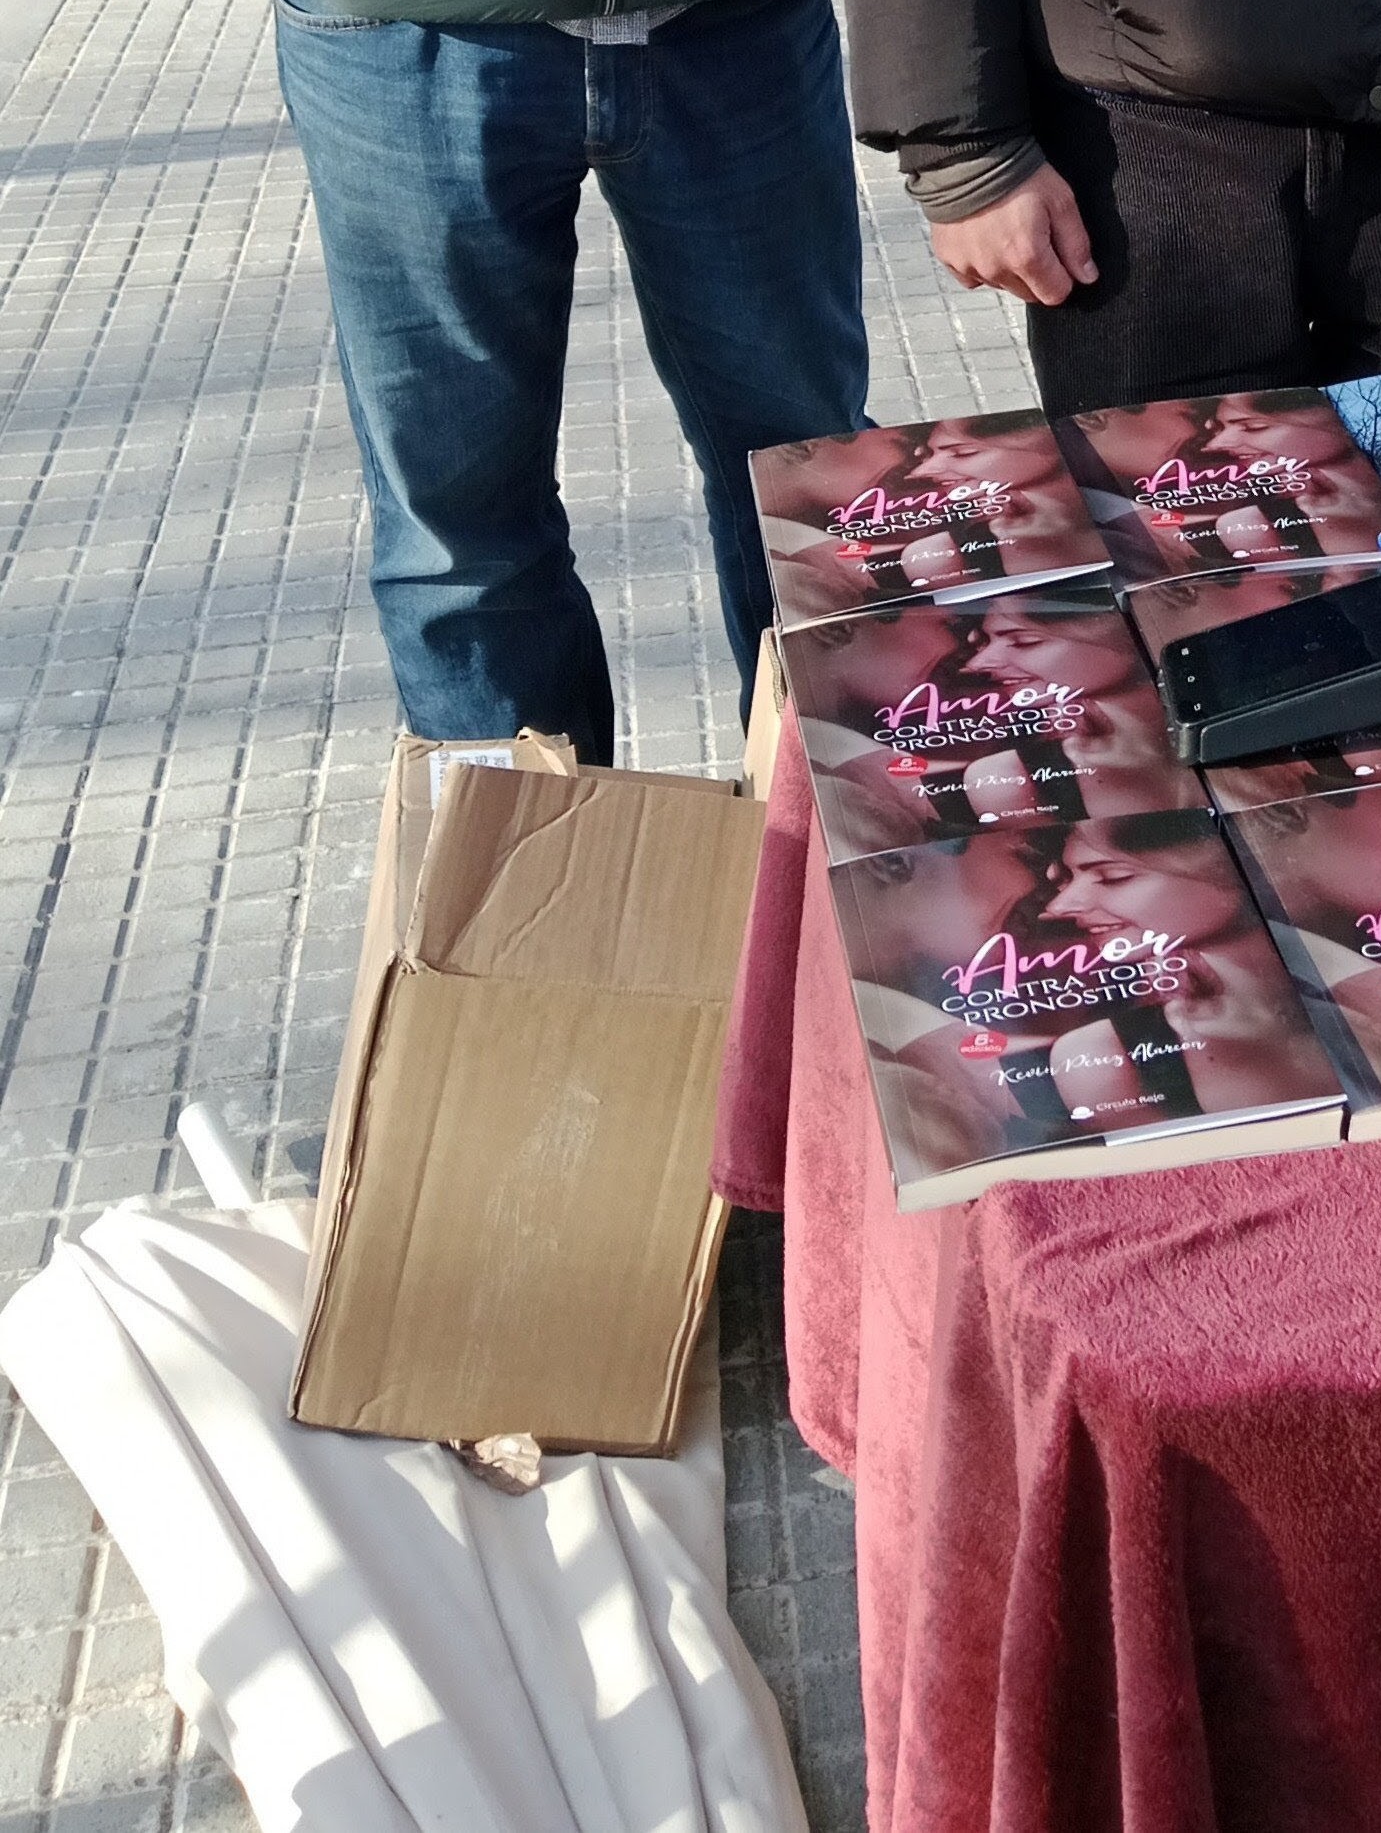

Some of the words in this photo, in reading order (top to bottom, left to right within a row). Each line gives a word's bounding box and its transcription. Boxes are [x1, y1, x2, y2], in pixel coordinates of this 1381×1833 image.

[1134, 455, 1311, 493] Amor
[1135, 481, 1238, 505] CONTRA
[1245, 470, 1312, 488] TODO
[826, 508, 934, 535] CONTRA
[942, 494, 1011, 515] TODO
[828, 480, 1014, 524] Amor
[1152, 481, 1306, 511] PRONÓSTICO
[842, 505, 1003, 542] PRONÓSTICO
[873, 680, 1086, 733] Amor
[873, 714, 991, 744] CONTRA
[1001, 701, 1086, 724] TODO
[891, 716, 1078, 753] PRONÓSTICO
[942, 928, 1187, 999] Amor
[941, 974, 1079, 1014] CONTRA
[1089, 956, 1188, 986] TODO
[963, 974, 1180, 1027] PRONÓSTICO
[989, 1062, 1059, 1087] Kevin
